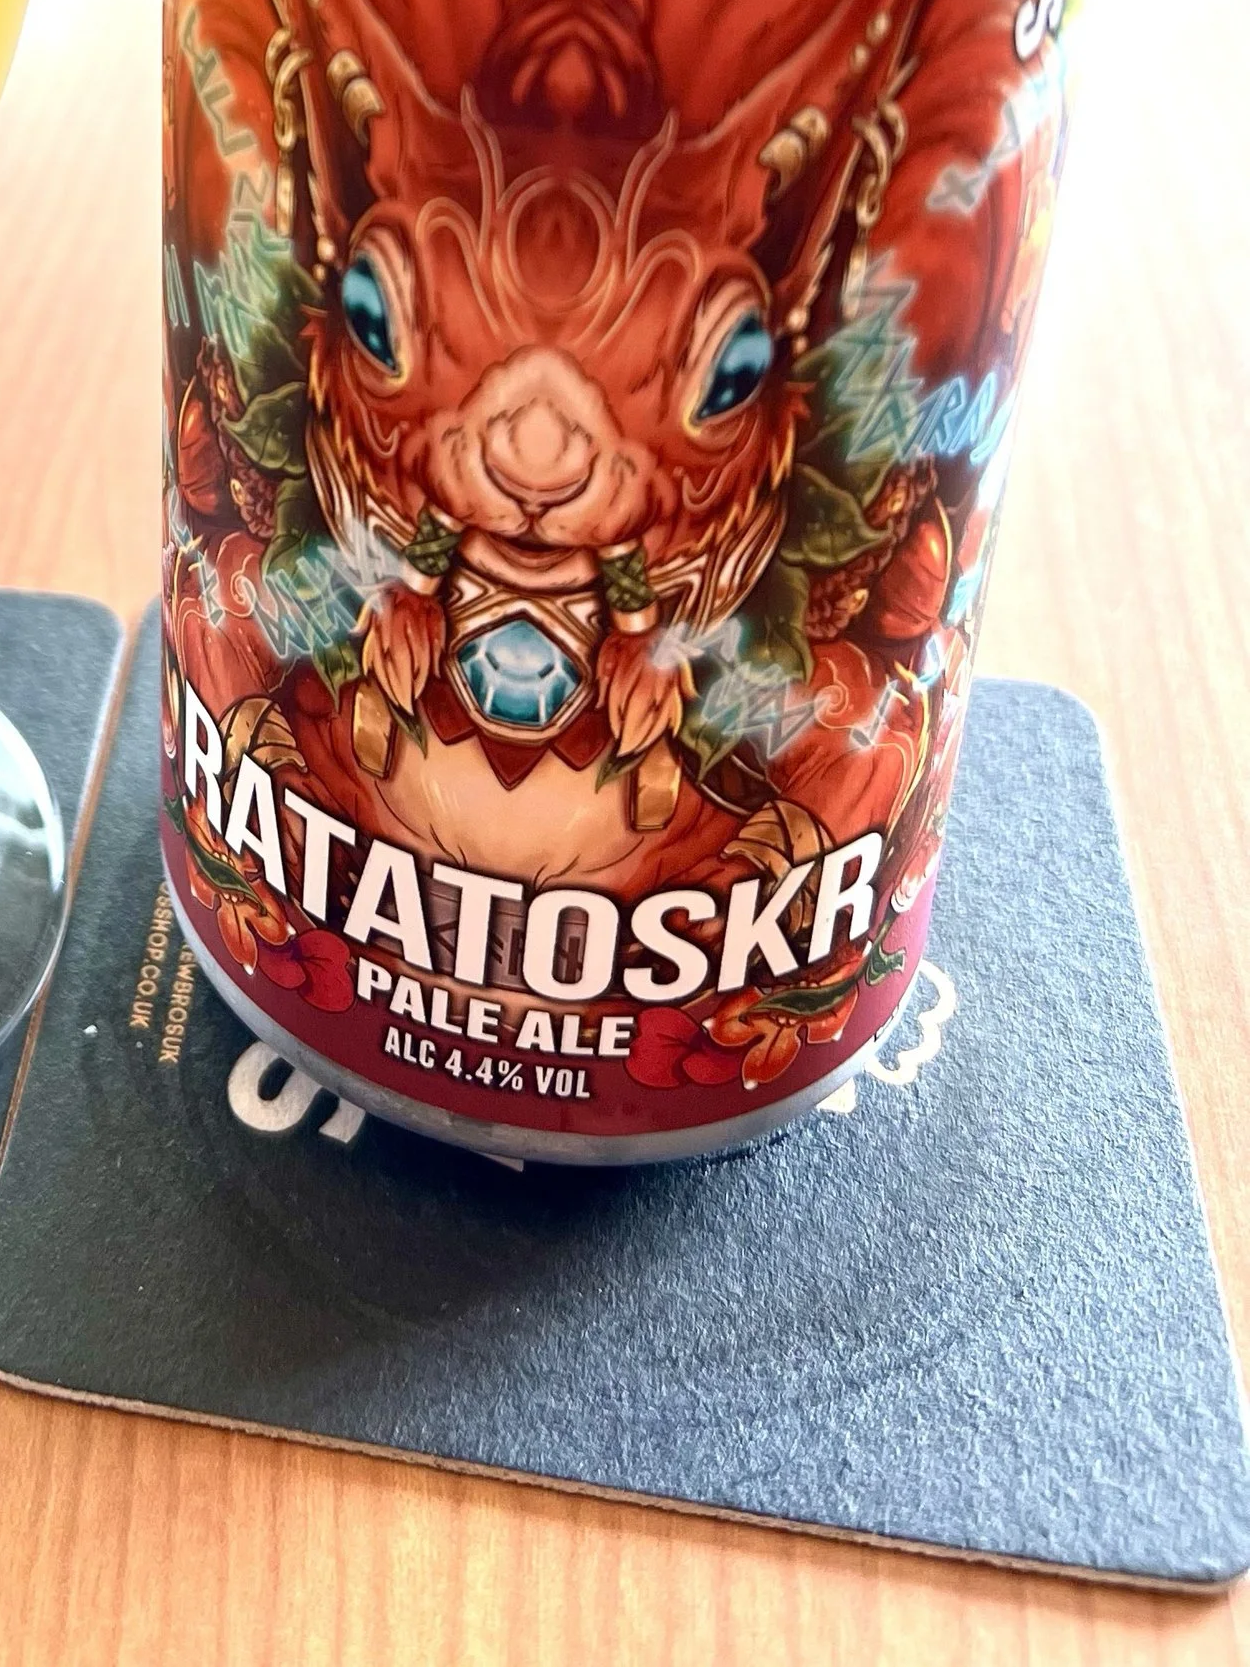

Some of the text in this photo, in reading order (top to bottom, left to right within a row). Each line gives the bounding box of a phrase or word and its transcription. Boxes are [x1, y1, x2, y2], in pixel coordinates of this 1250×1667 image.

[182, 680, 883, 1002] RATATOSKR
[356, 956, 632, 1057] PALE ALE
[384, 1026, 591, 1099] ALC 4.4% VOL
